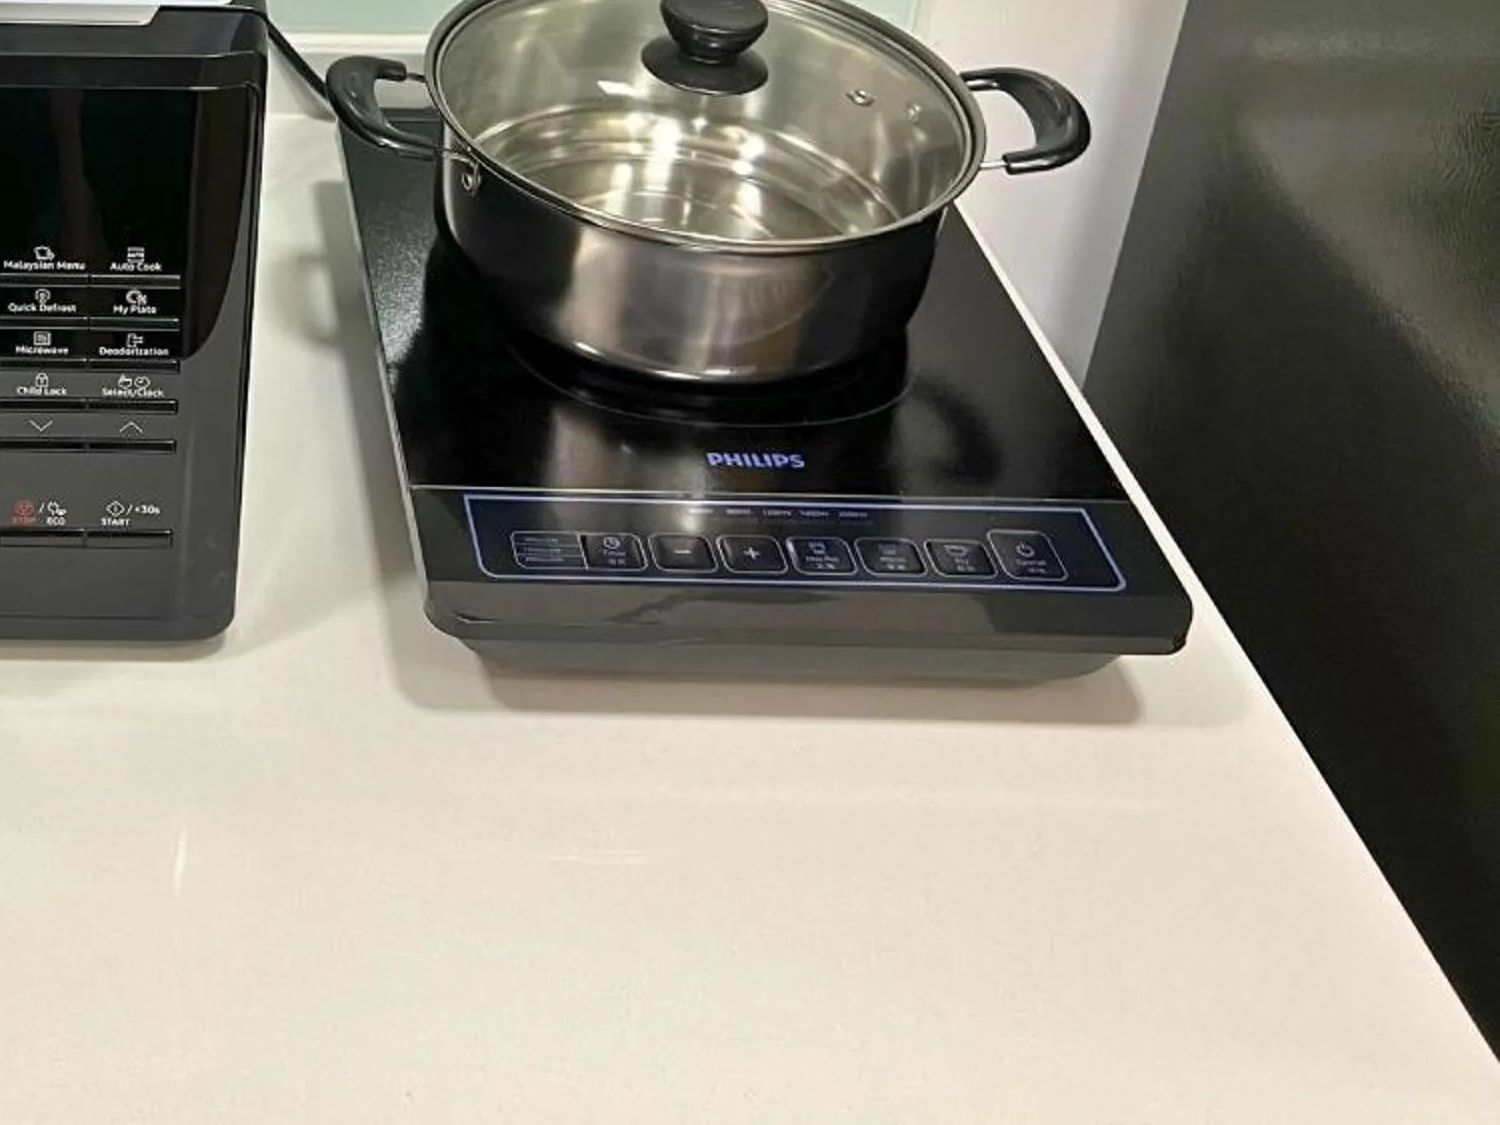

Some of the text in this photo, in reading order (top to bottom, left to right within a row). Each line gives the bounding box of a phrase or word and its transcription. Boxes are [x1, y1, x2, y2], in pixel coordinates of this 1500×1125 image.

[3, 261, 86, 271] Malaysian Menu
[110, 262, 162, 272] Auto Cook
[7, 302, 77, 313] Quick Defrost
[113, 304, 157, 315] My Plate
[15, 345, 69, 355] Microwave
[99, 346, 169, 356] Deodorization
[16, 386, 67, 396] Child Lock
[707, 452, 805, 469] PHILIPS
[46, 517, 67, 526] ECO
[101, 517, 131, 526] START
